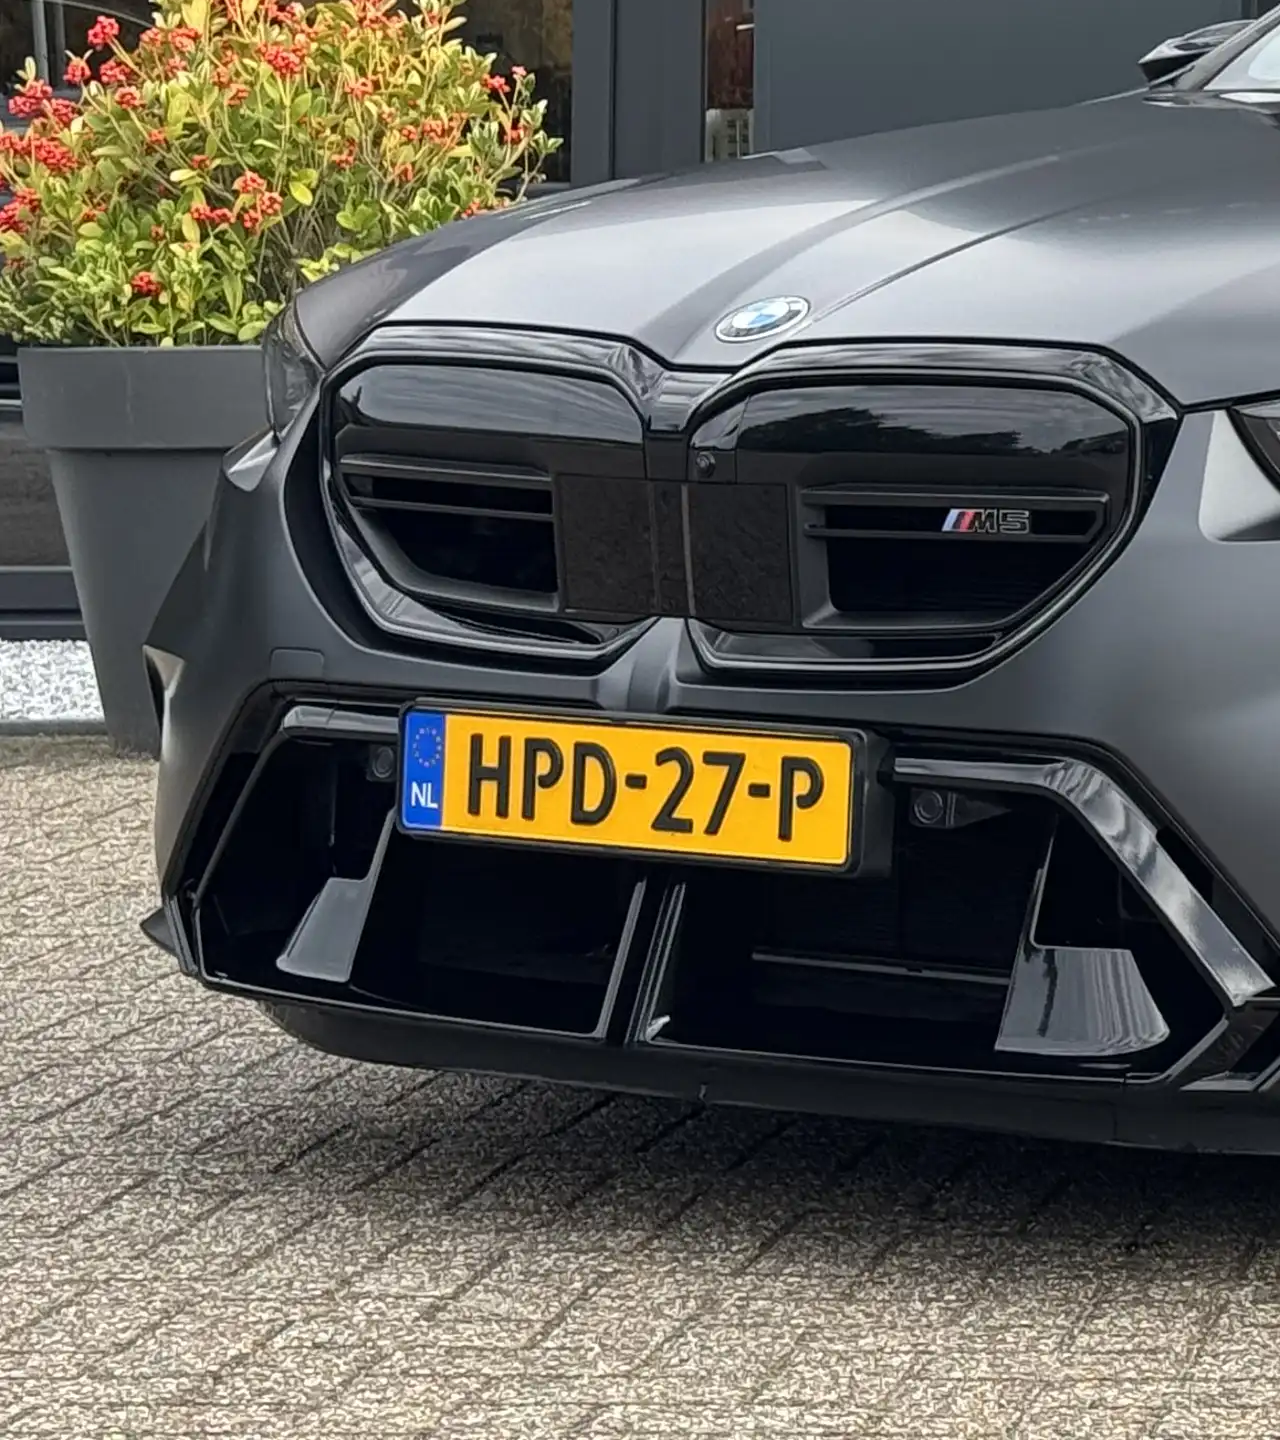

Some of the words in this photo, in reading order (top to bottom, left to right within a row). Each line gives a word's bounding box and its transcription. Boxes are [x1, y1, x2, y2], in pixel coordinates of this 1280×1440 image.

[962, 508, 1030, 534] M5
[410, 780, 439, 811] NL
[466, 732, 825, 842] HPD-27-P
